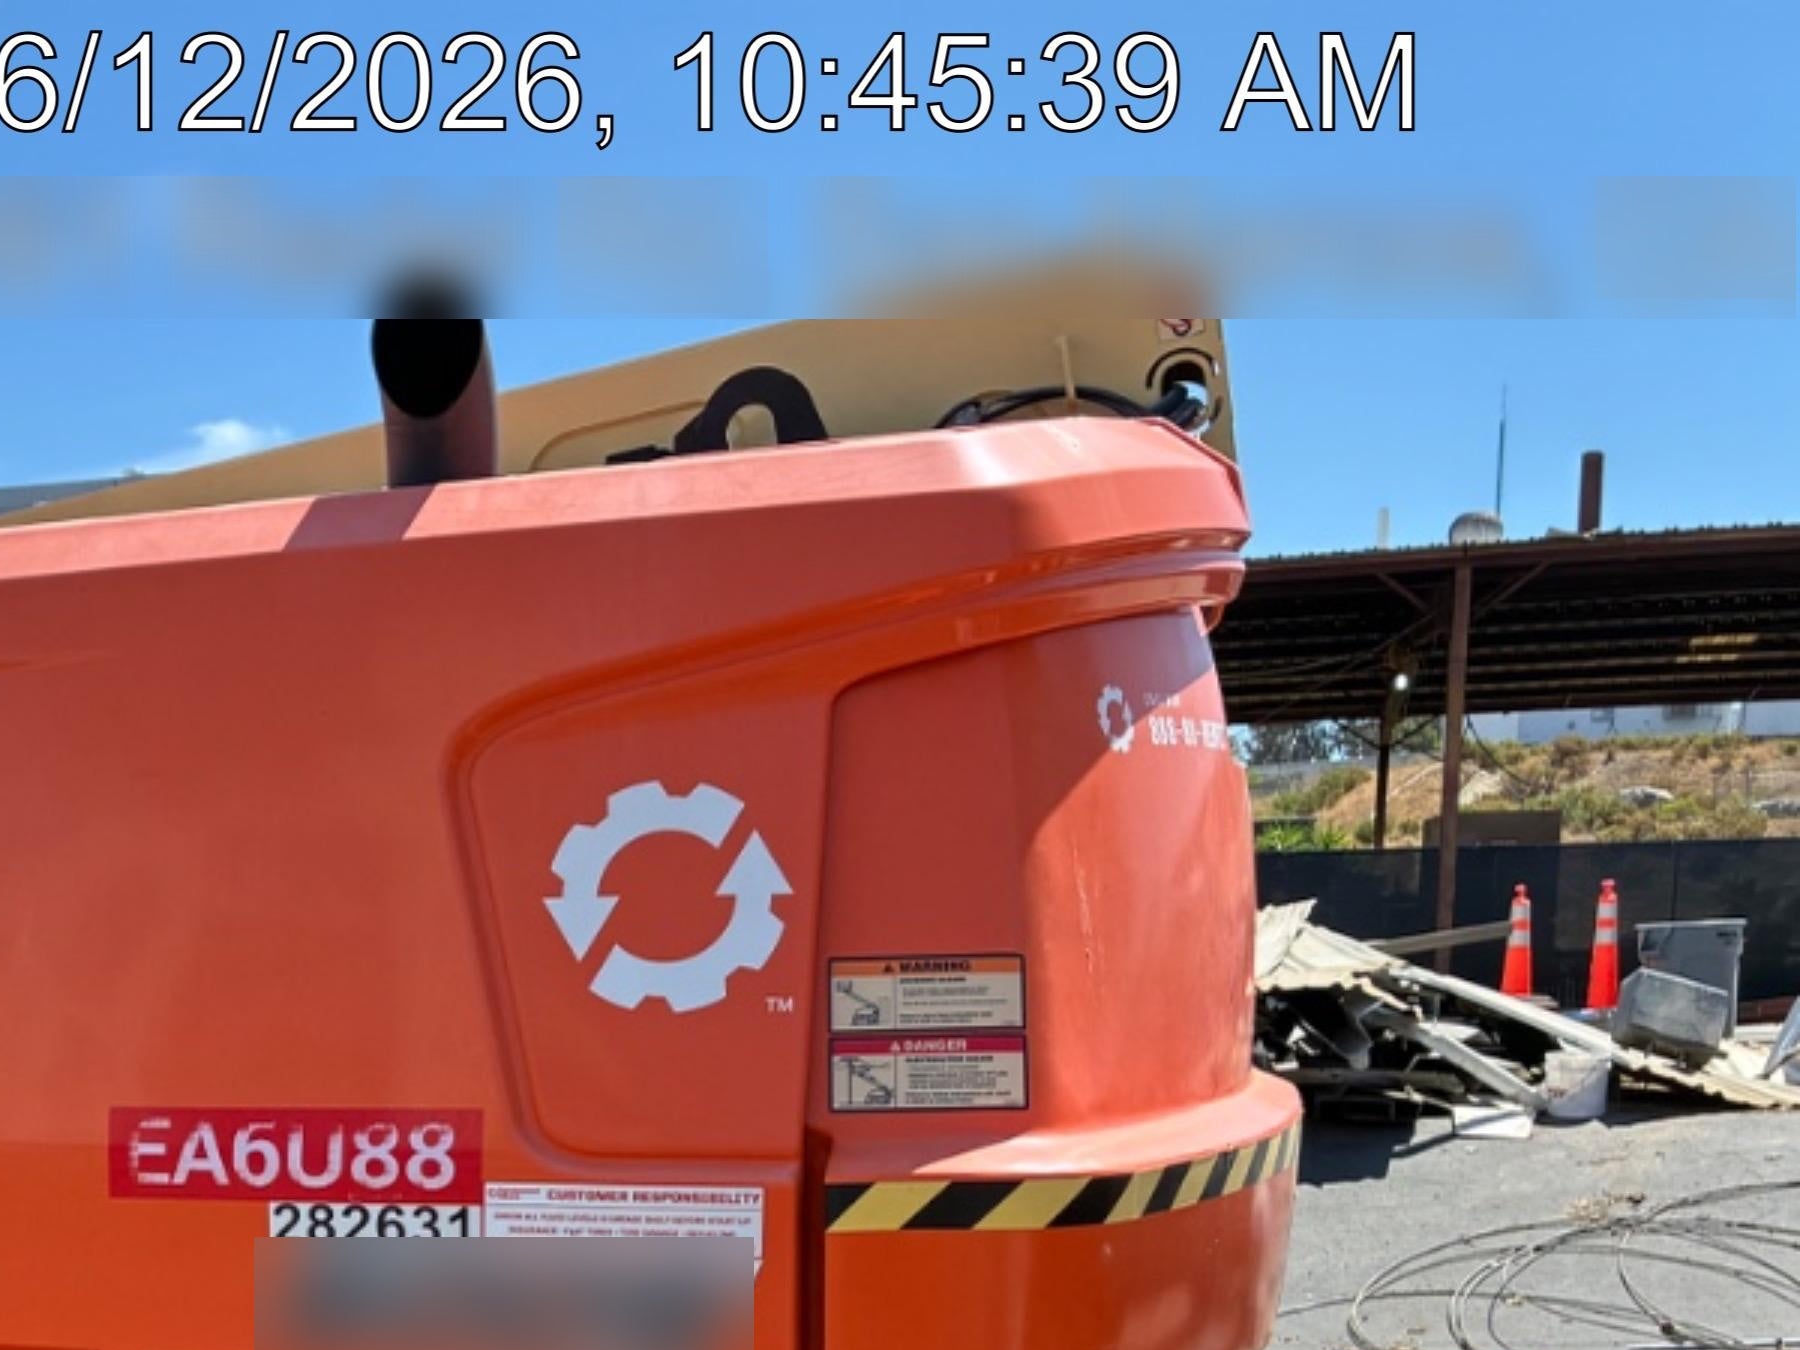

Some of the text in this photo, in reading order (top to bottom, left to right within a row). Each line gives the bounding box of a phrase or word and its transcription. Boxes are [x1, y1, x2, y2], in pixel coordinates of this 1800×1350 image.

[765, 996, 793, 1013] TM
[903, 1039, 967, 1053] DANGER
[129, 1115, 456, 1190] EA6U88
[546, 1188, 629, 1203] CUSTOMER
[632, 1190, 760, 1205] RESPONSIBILITY
[273, 1202, 470, 1237] 282631
